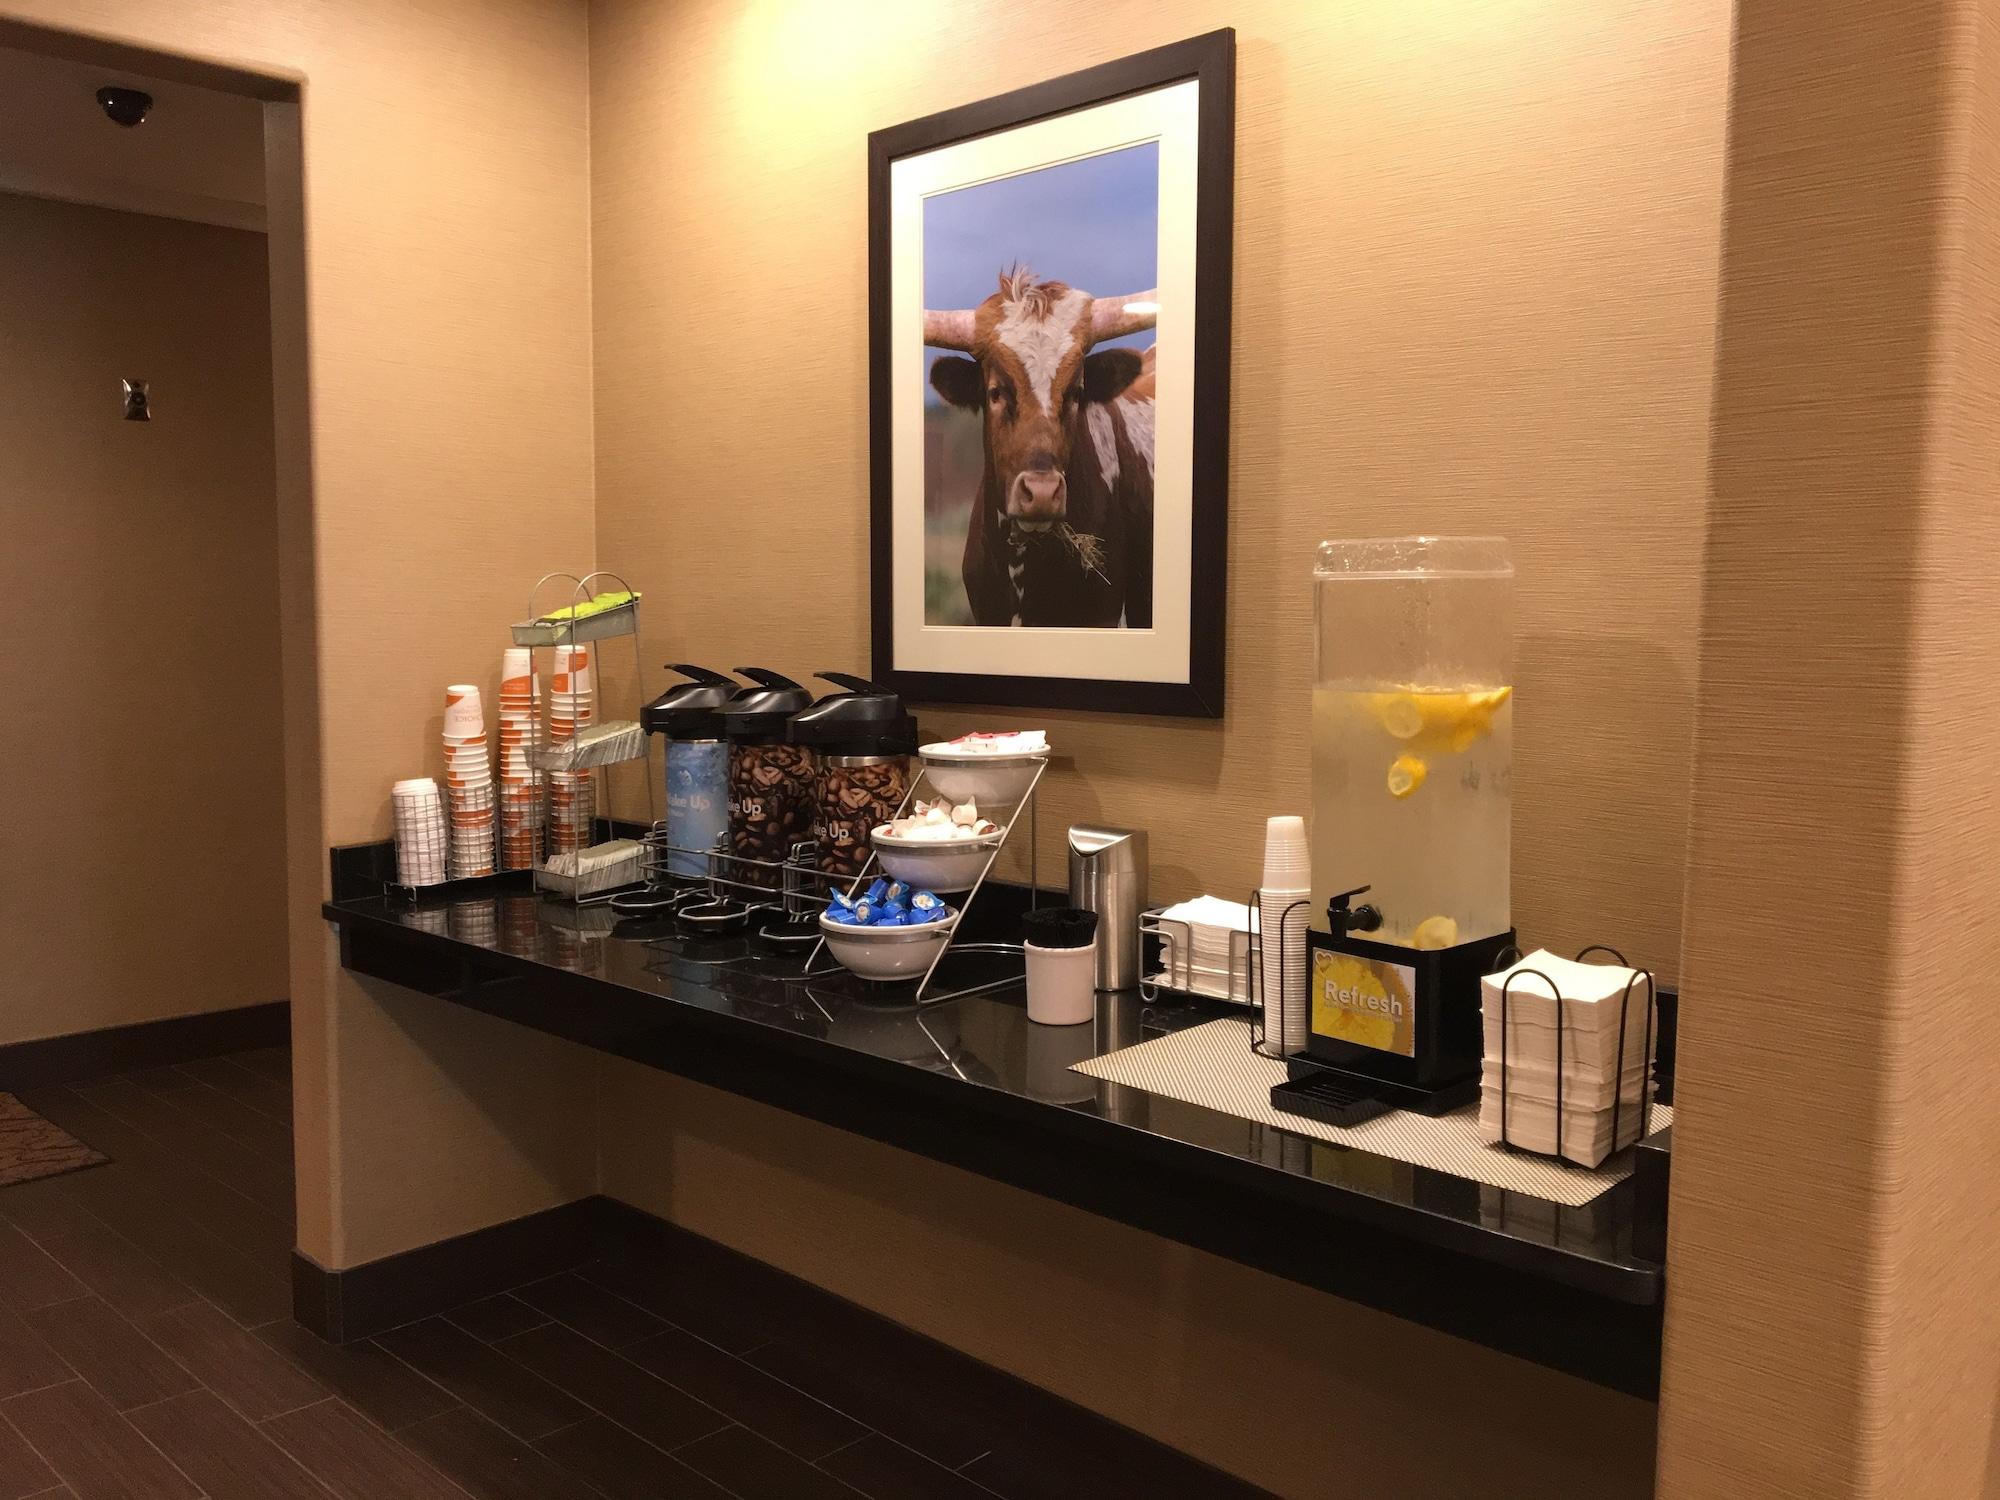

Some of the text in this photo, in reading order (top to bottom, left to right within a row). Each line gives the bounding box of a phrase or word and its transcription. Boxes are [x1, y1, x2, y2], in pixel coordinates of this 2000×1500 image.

[667, 793, 710, 812] ake Up
[742, 799, 761, 816] Up
[829, 822, 849, 841] Up
[1324, 979, 1402, 1016] Refresh
